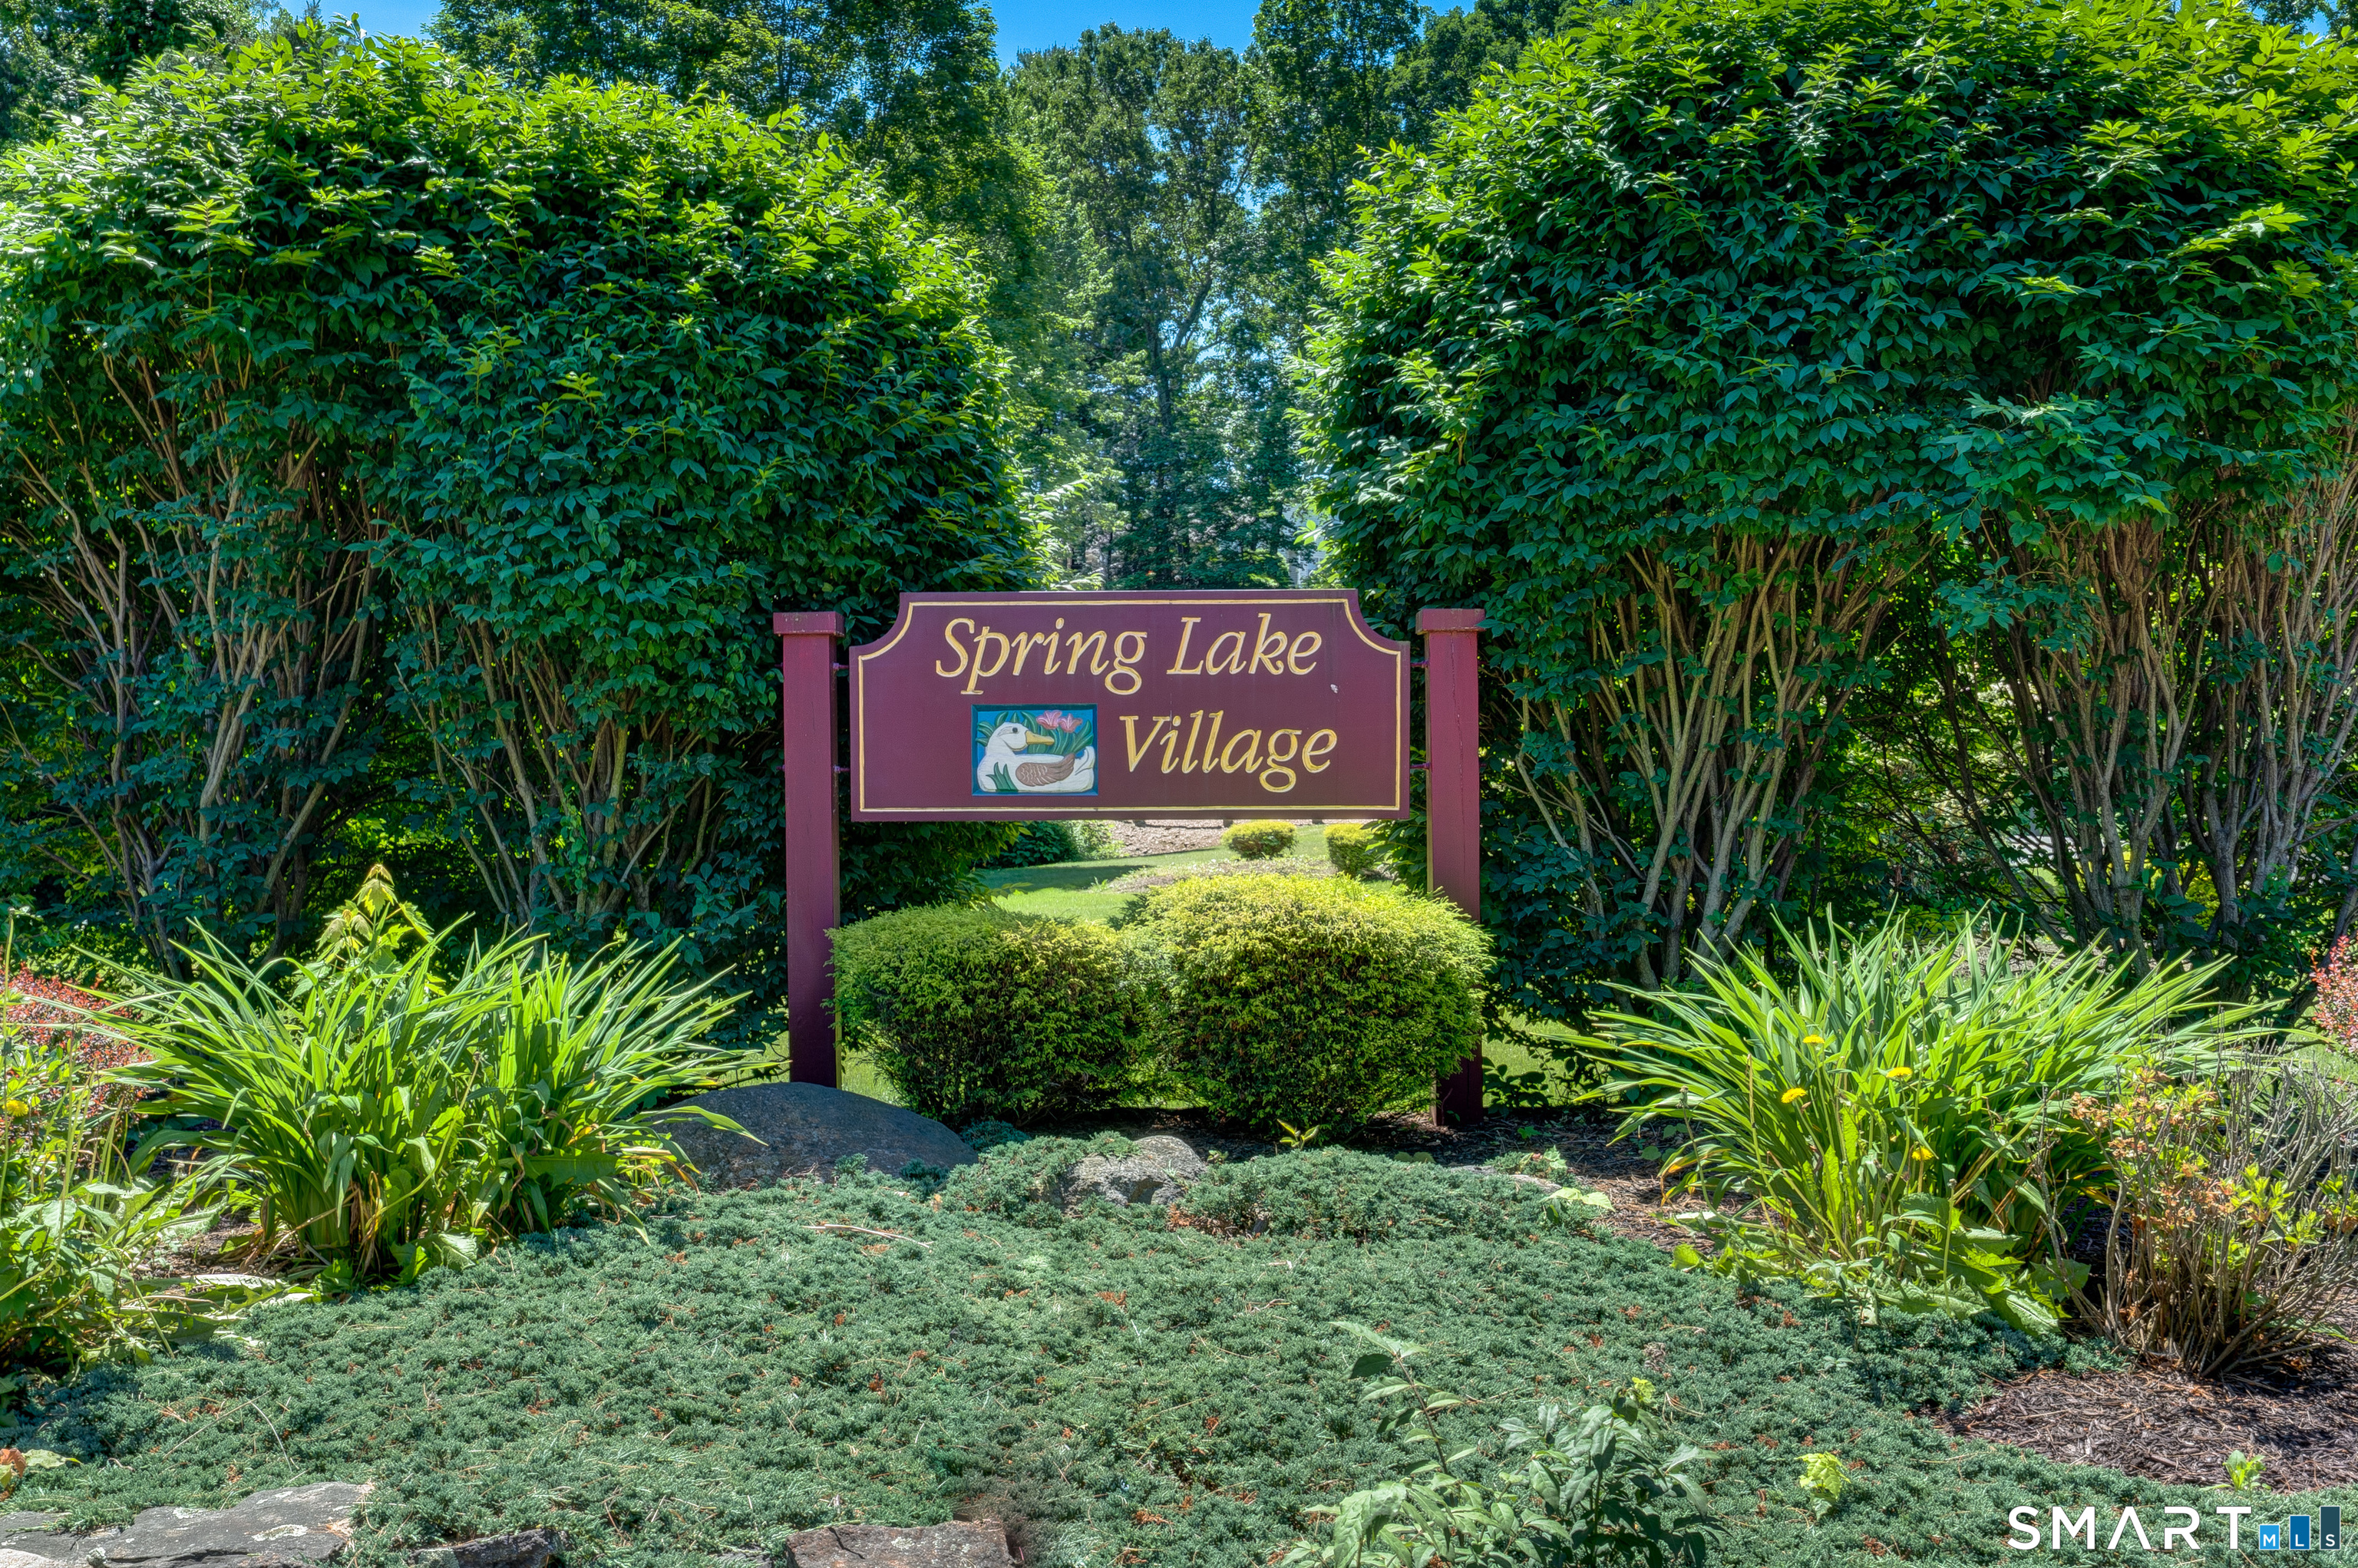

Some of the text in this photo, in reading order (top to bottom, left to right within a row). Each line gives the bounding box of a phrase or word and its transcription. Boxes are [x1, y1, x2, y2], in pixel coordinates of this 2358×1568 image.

[936, 613, 1322, 695] Spring Lake
[1119, 710, 1337, 793] Village
